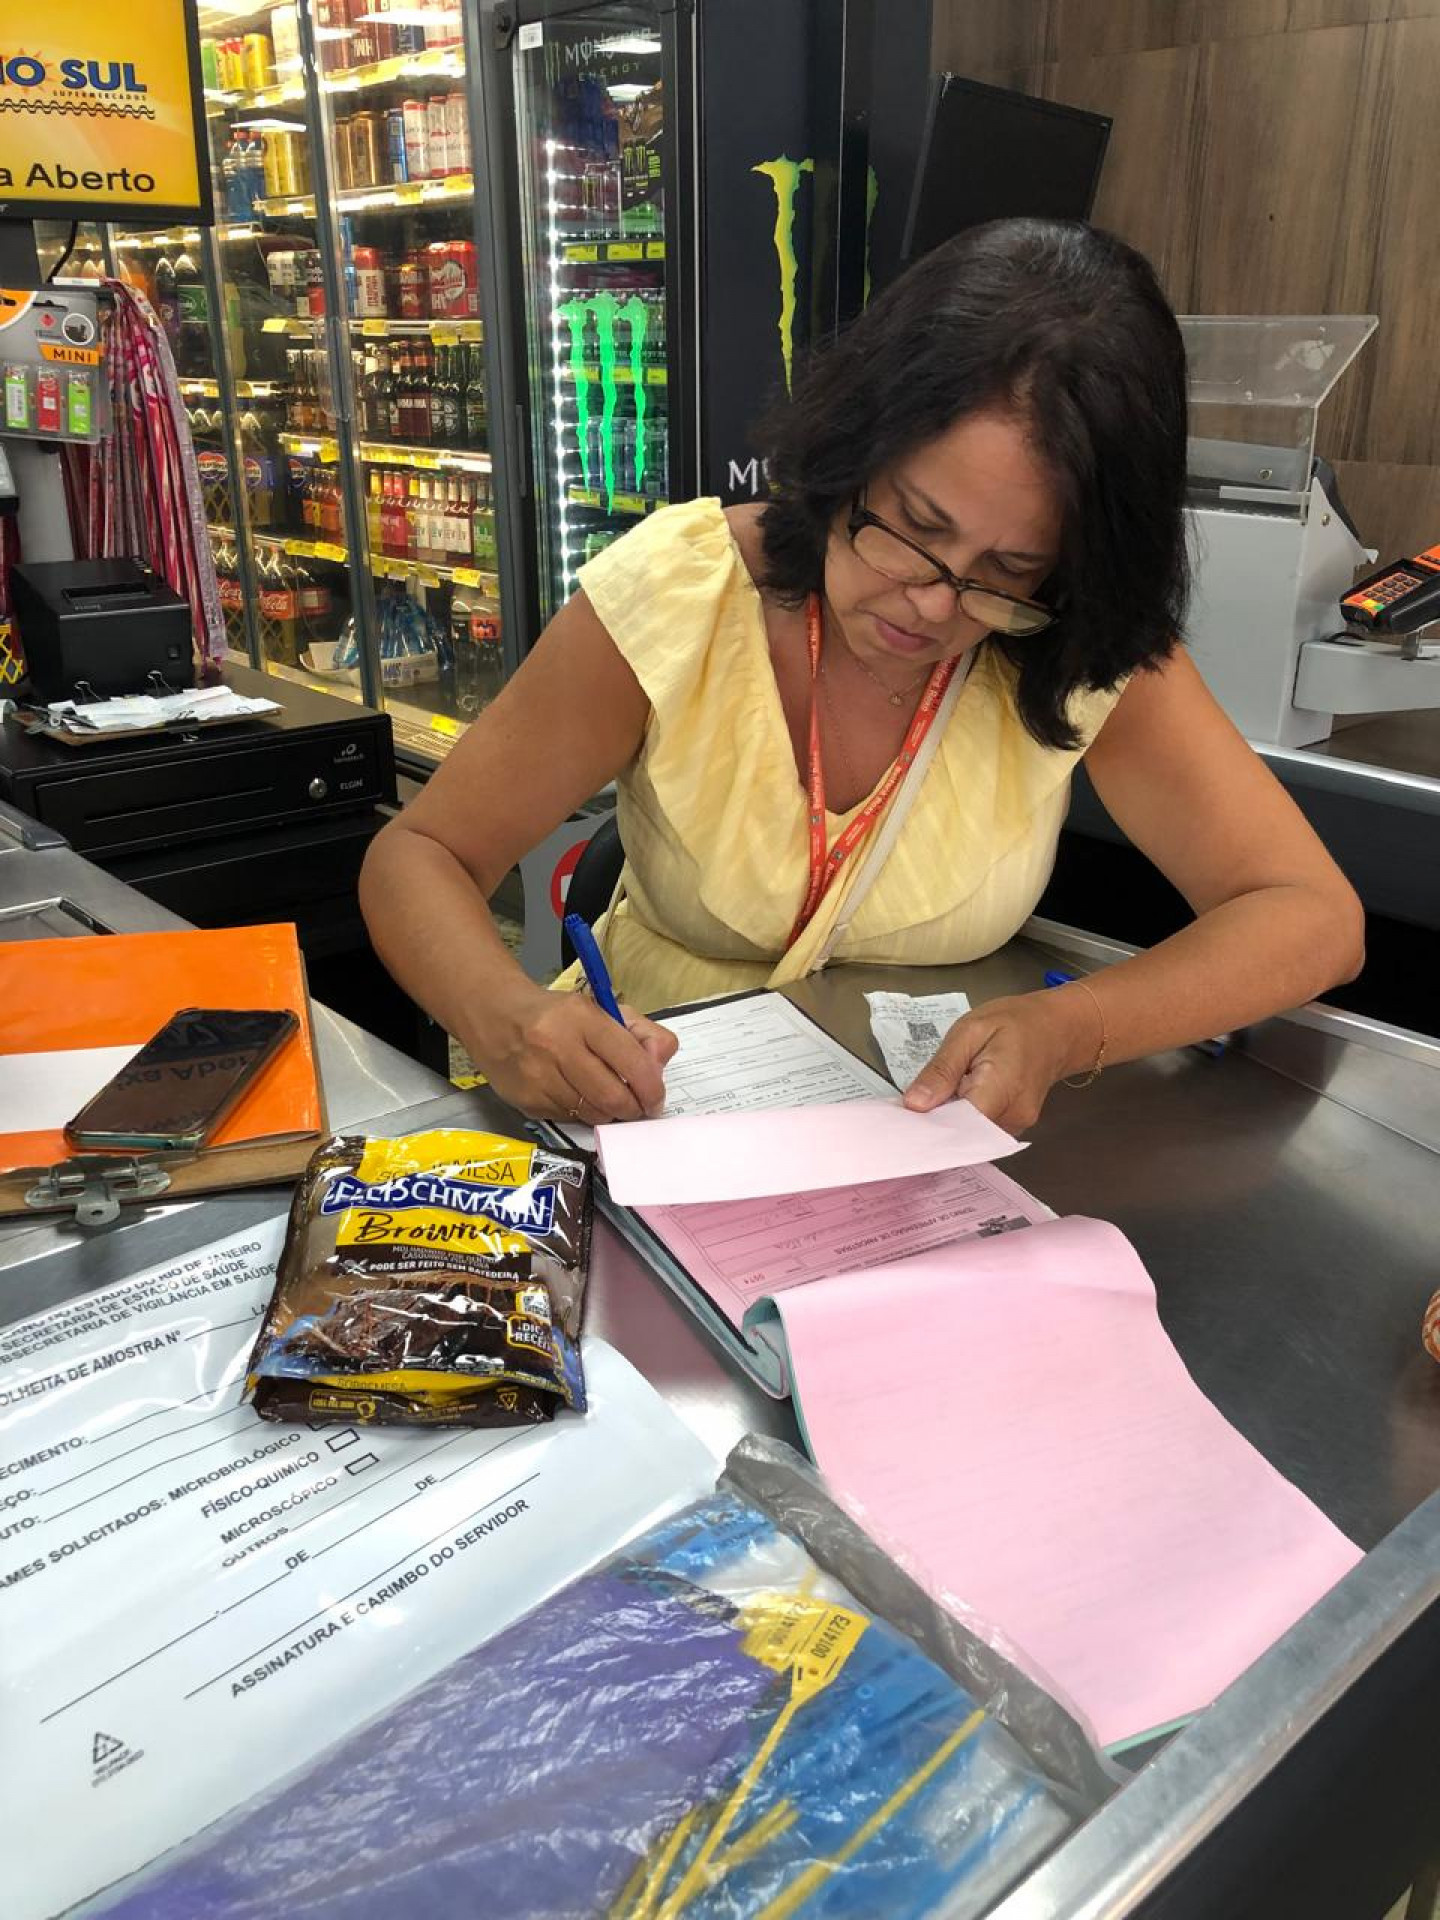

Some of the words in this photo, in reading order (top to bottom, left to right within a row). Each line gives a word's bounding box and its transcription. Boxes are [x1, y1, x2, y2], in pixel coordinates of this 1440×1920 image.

[53, 90, 147, 101] SUPERMERCADOS
[60, 59, 148, 94] SUL
[25, 162, 156, 193] Aberto
[52, 347, 92, 363] MINI
[369, 1261, 395, 1272] PODE
[396, 1260, 417, 1270] SER
[418, 1259, 445, 1269] FEITO
[1, 1311, 99, 1351] SECRETARIA
[100, 1301, 122, 1316] DE
[122, 1280, 179, 1306] ESTADO
[181, 1275, 201, 1288] DE
[110, 1308, 133, 1323] DE
[132, 1284, 211, 1313] VIGILÂNCIA
[211, 1277, 234, 1292] EM
[67, 1362, 90, 1382] DE
[92, 1337, 166, 1373] AMOSTRA
[48, 1498, 168, 1564] SOLICITADOS:
[219, 1476, 338, 1544] MICROSCÓPICO
[284, 1549, 310, 1570] DE
[414, 1474, 438, 1492] DE
[221, 1526, 289, 1569] OUTROS
[230, 1621, 342, 1698] ASSINATURA
[339, 1612, 355, 1627] E
[356, 1563, 430, 1616] CARIMBO
[428, 1546, 455, 1568] DO
[454, 1499, 531, 1552] SERVIDOR
